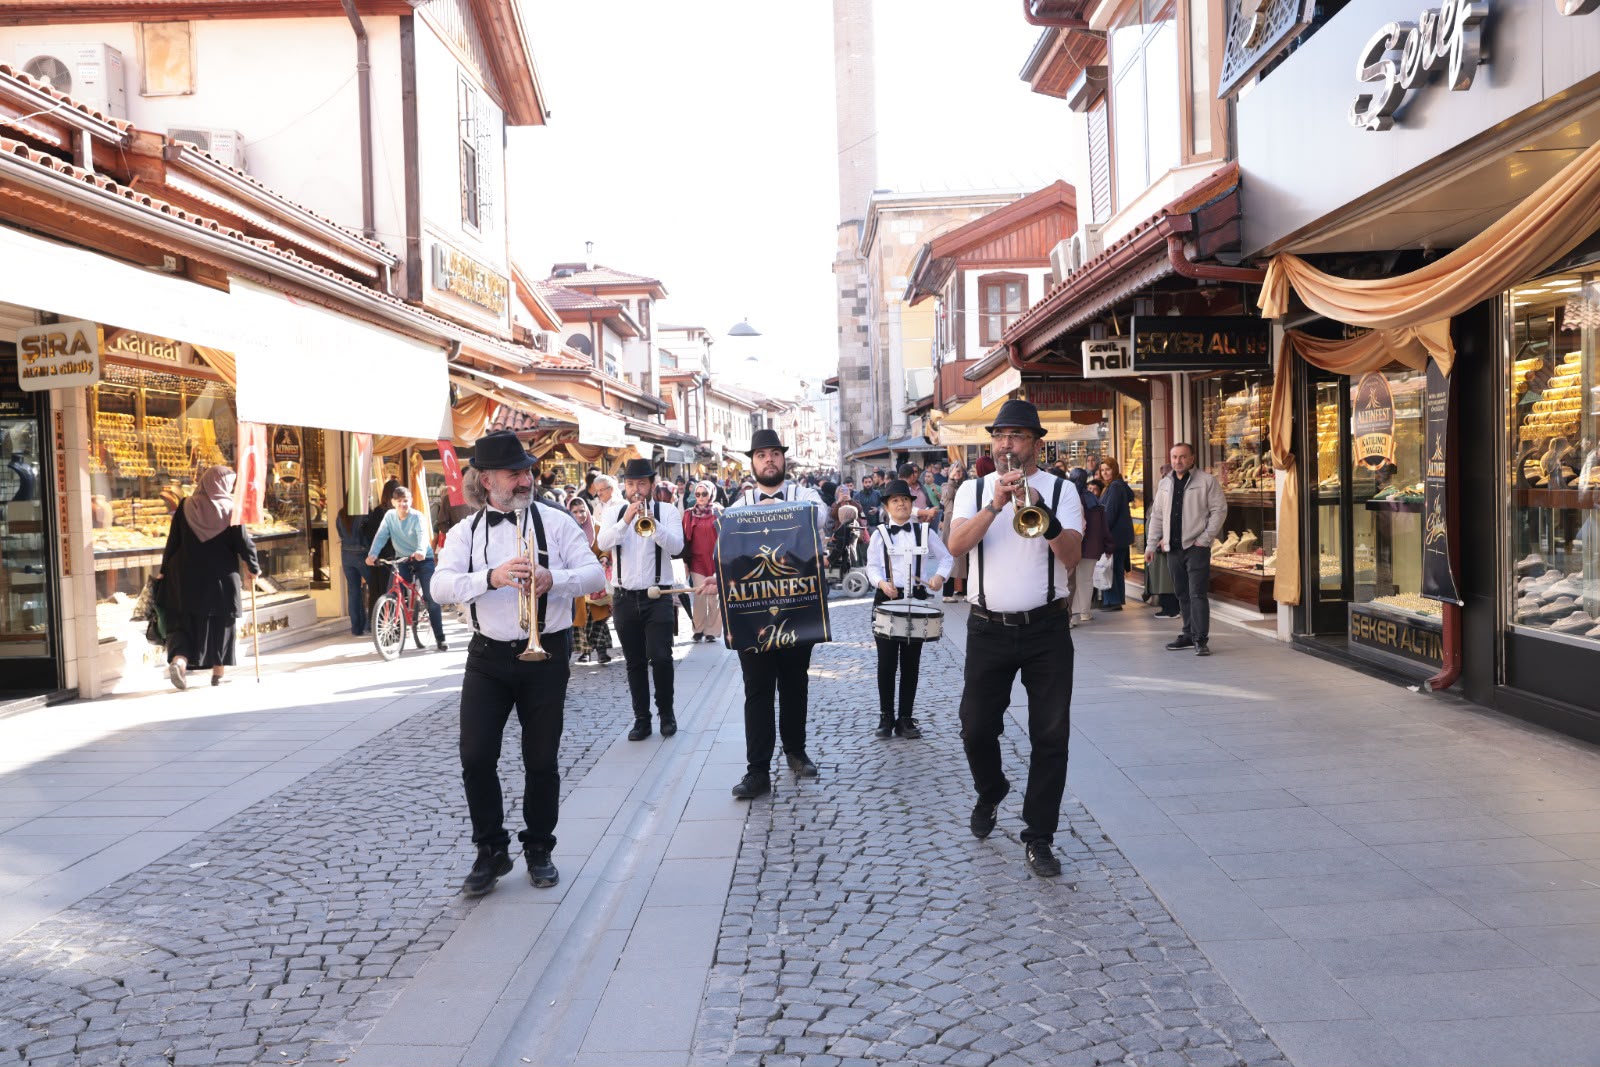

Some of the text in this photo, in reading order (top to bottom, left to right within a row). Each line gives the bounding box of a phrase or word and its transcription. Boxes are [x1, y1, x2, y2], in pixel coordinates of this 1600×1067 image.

[21, 329, 92, 364] ŞİRA
[1090, 347, 1131, 370] nal
[727, 575, 818, 602] ALTINFEST
[757, 618, 799, 652] Hoş
